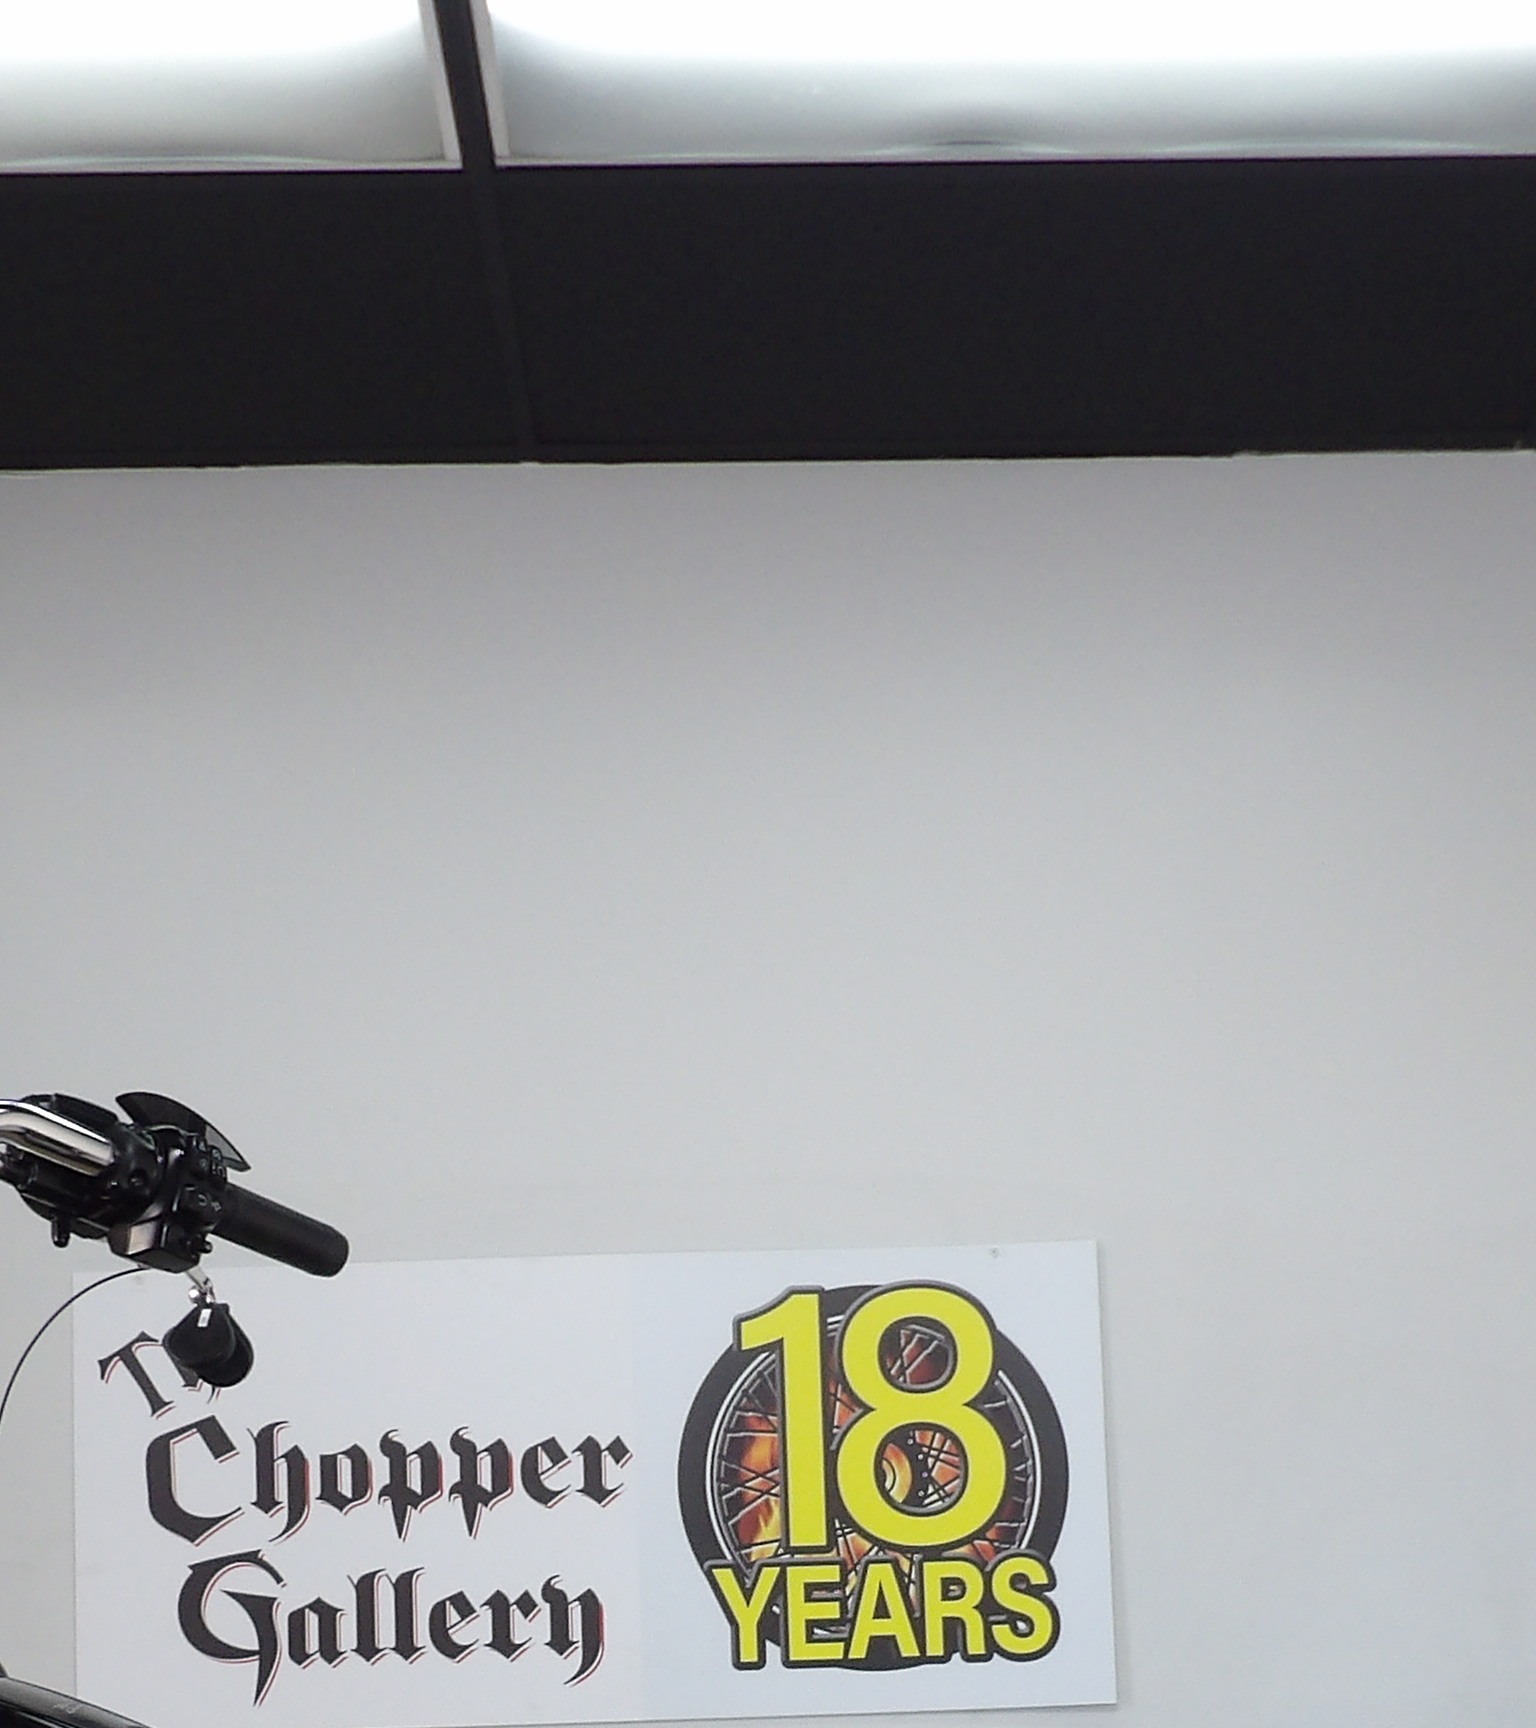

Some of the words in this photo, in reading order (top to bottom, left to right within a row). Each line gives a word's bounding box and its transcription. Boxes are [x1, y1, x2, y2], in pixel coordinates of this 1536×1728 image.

[146, 1416, 631, 1545] Chopper
[737, 1284, 1008, 1550] 18
[178, 1550, 604, 1705] Gallery
[709, 1554, 1056, 1665] YEARS
